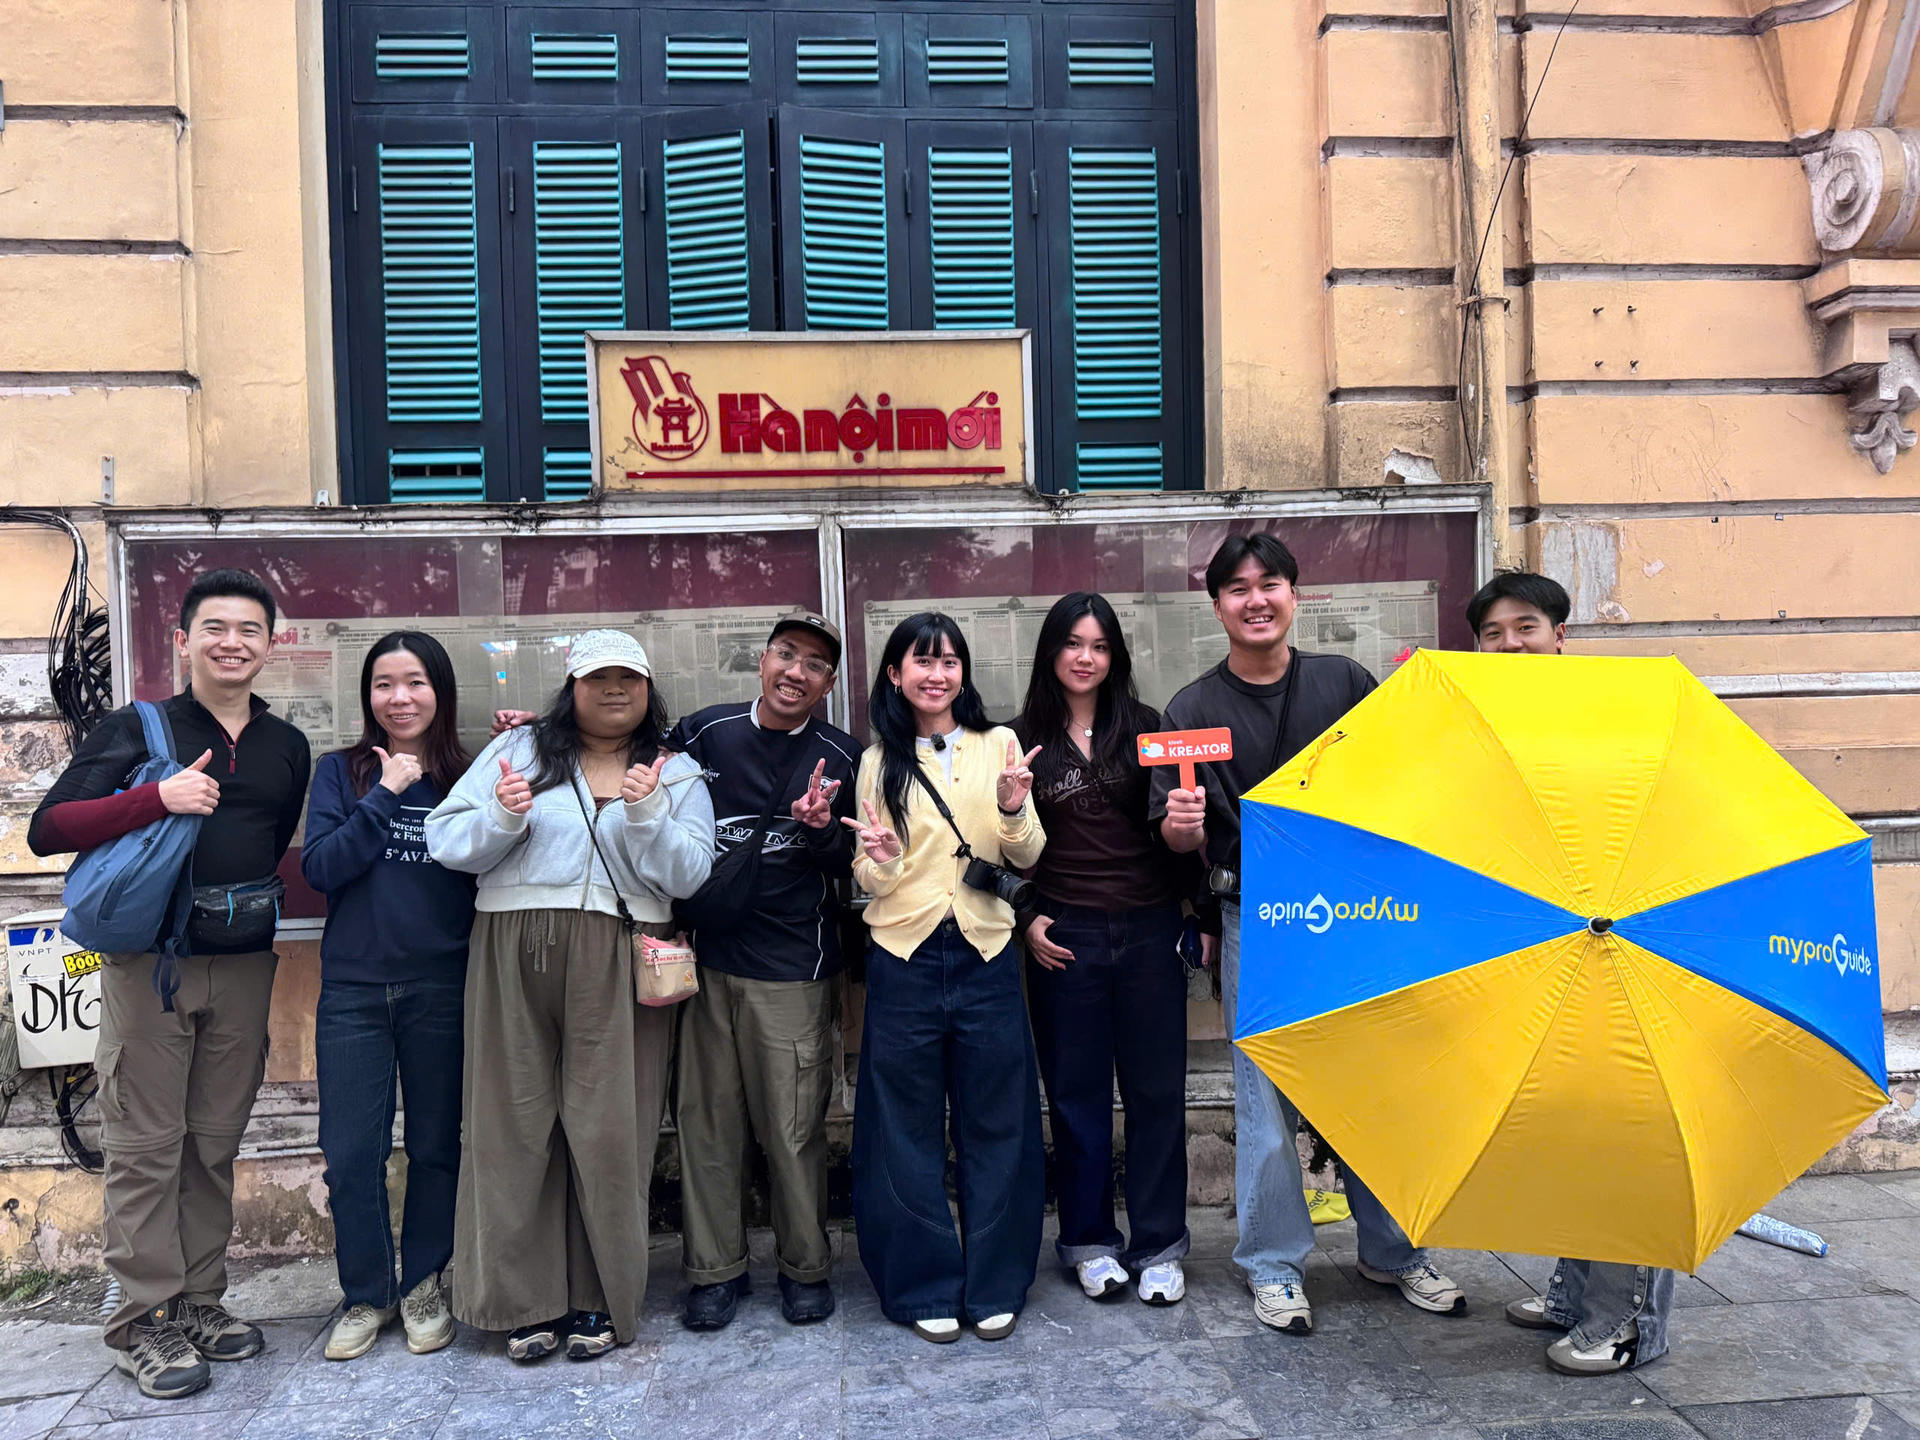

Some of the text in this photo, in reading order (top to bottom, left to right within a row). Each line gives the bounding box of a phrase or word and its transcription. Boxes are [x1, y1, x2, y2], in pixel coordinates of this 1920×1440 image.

[1169, 743, 1229, 757] KREATOR
[393, 831, 401, 839] &
[1259, 893, 1418, 934] myproGuide
[19, 947, 52, 957] VNPT
[1769, 933, 1872, 976] myproGuide
